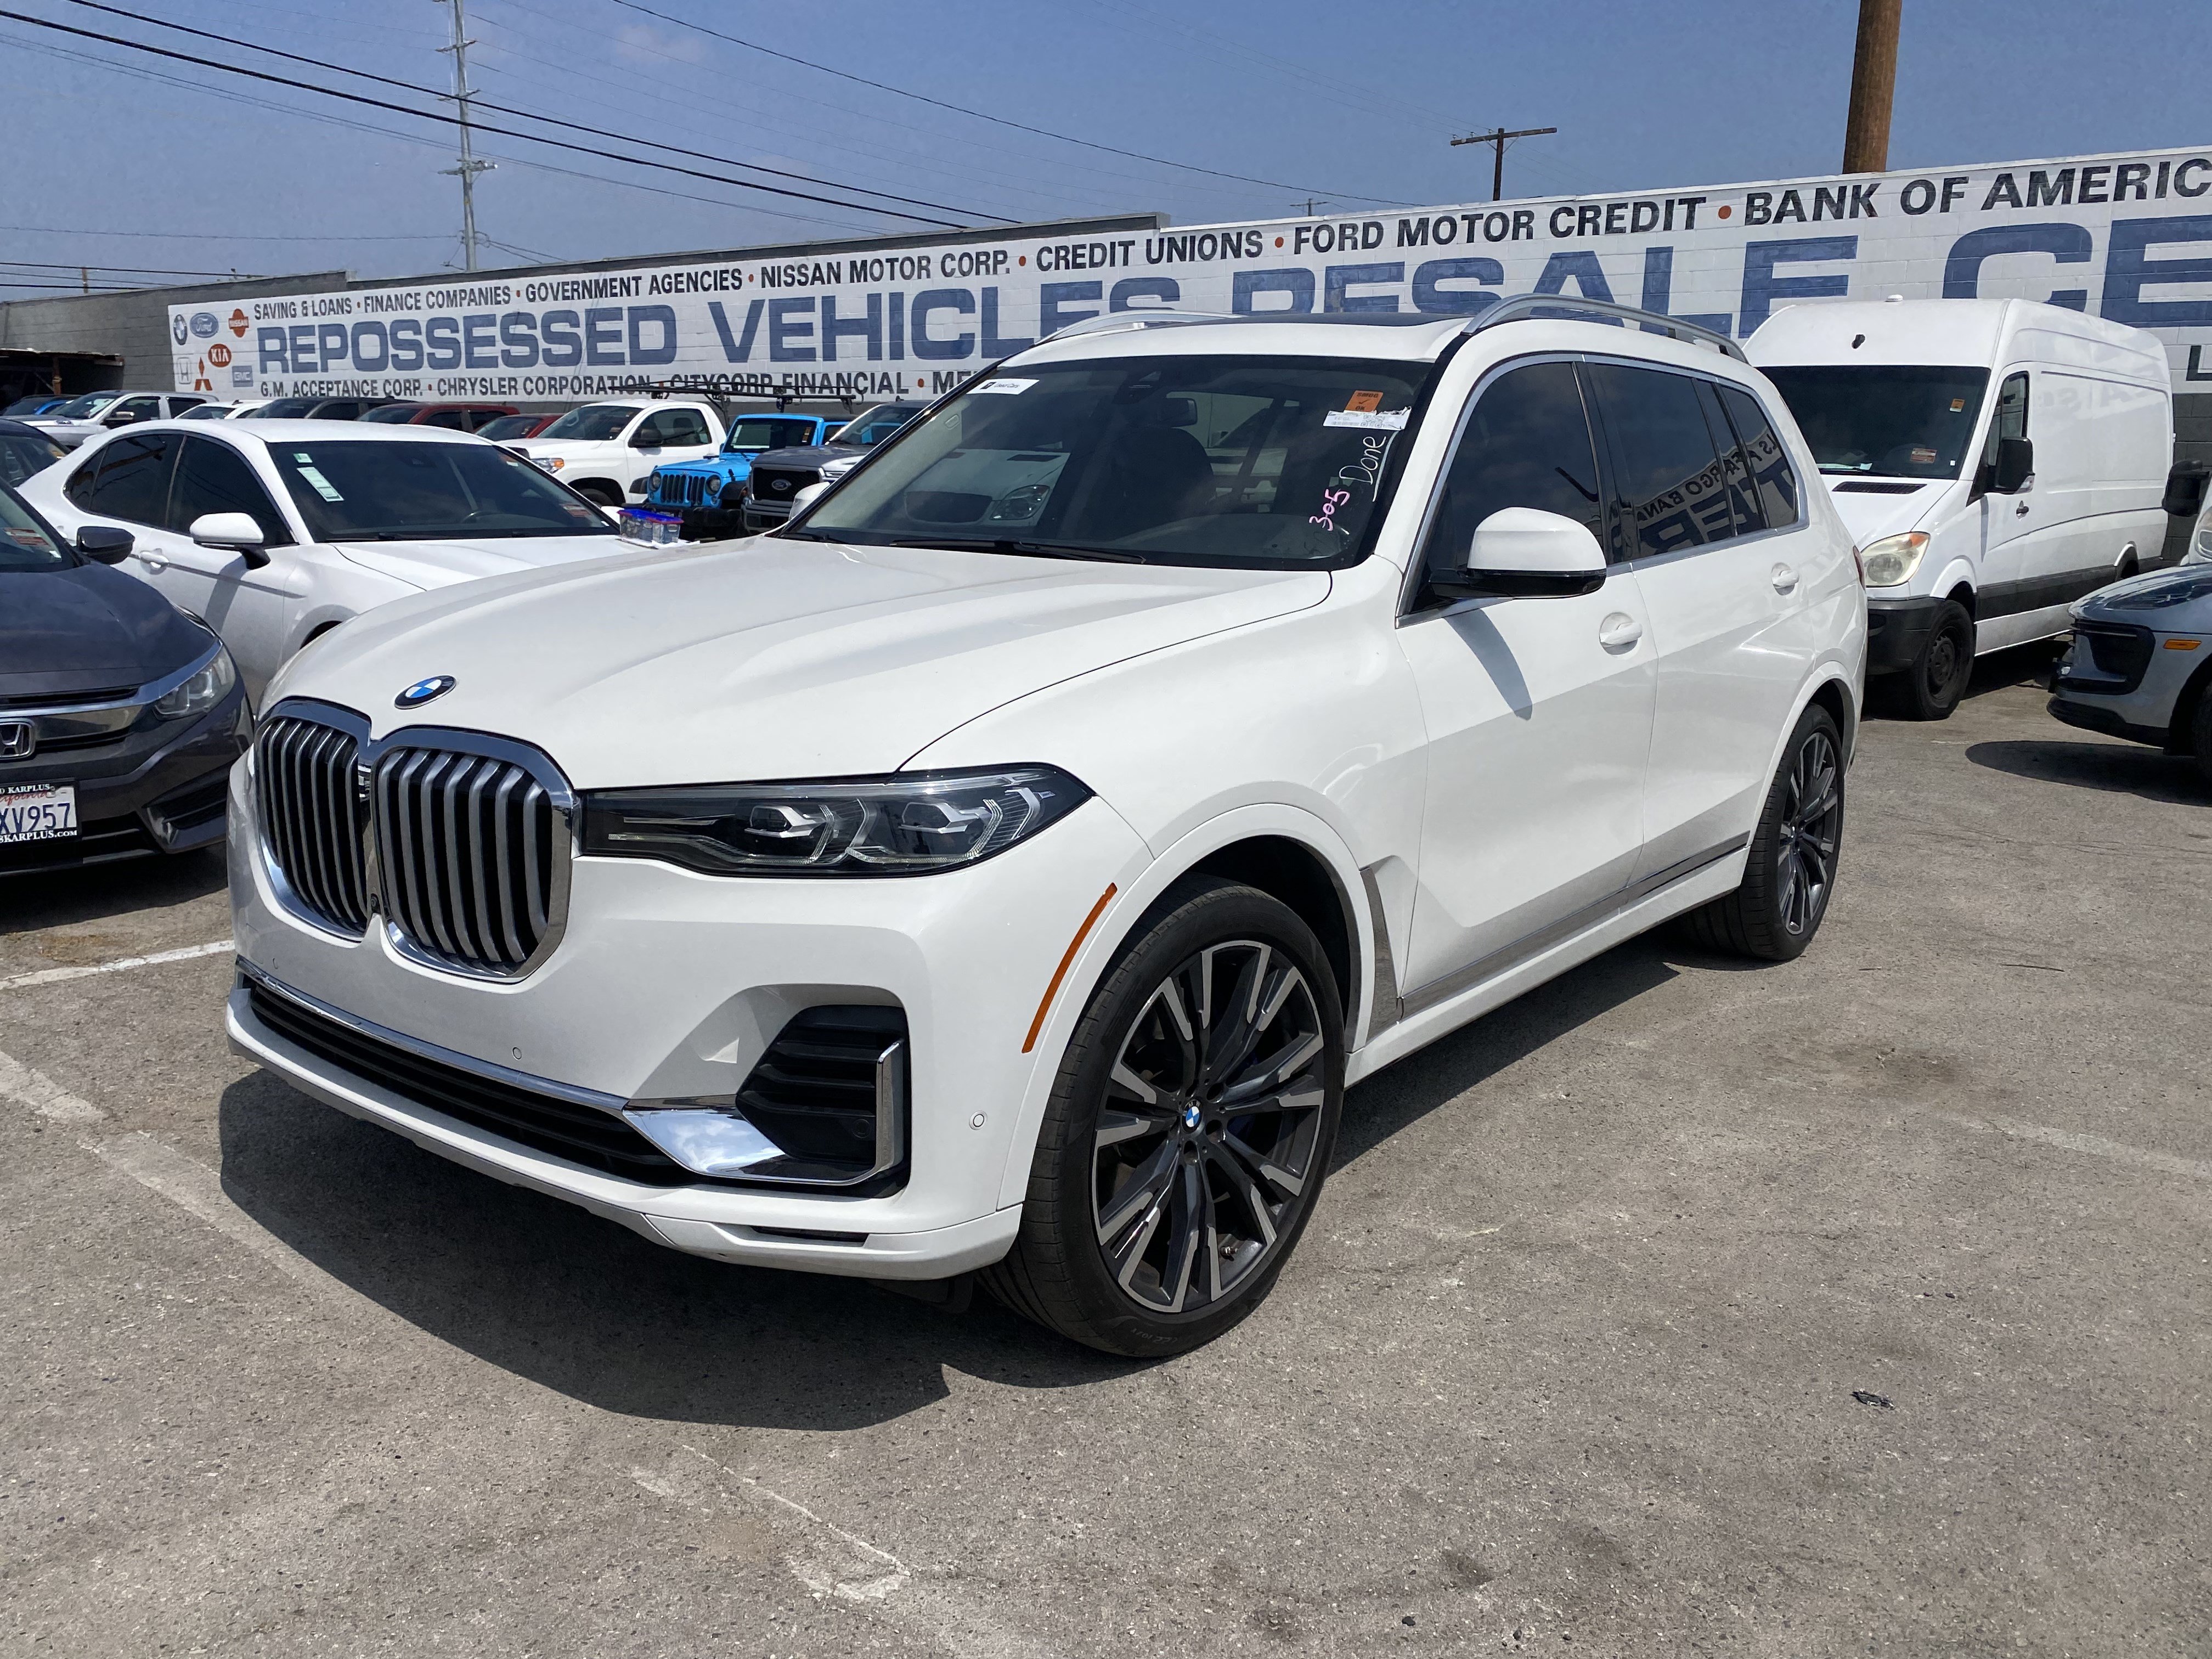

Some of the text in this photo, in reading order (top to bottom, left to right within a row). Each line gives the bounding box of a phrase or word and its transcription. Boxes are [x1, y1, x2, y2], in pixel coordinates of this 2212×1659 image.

[254, 301, 297, 320] SAVING
[311, 297, 352, 316] LOANS
[364, 292, 421, 313] FINANCE
[425, 285, 511, 308] COMPANIES
[526, 275, 642, 303] GOVERNMENT
[648, 268, 742, 296] AGENCIES
[761, 261, 841, 289] NISSAN
[849, 255, 932, 284] MOTOR
[940, 250, 1011, 278] CORP.
[1036, 240, 1135, 272] CREDIT
[1146, 229, 1263, 264] UNIONS
[1294, 221, 1384, 255] FORD
[1397, 210, 1534, 247] MOTOR
[1549, 196, 1706, 238] CREDIT
[1745, 183, 1881, 225] BANK
[1900, 176, 1969, 215] OF
[257, 305, 676, 374] REPOSSESSED
[210, 348, 229, 363] KIA
[234, 371, 251, 381] GMC
[261, 381, 288, 397] G.M.
[292, 379, 379, 398] ACCEPTANCE
[383, 378, 423, 397] CORP.
[438, 377, 518, 397] CHRYSLER
[523, 374, 650, 396] CORPORATION
[671, 373, 772, 394] CITYCORP
[782, 371, 909, 395] FINANCIAL
[1339, 436, 1386, 484] Done
[1309, 488, 1350, 532] 305
[8, 783, 50, 794] KARPLUS
[0, 803, 70, 833] XV957
